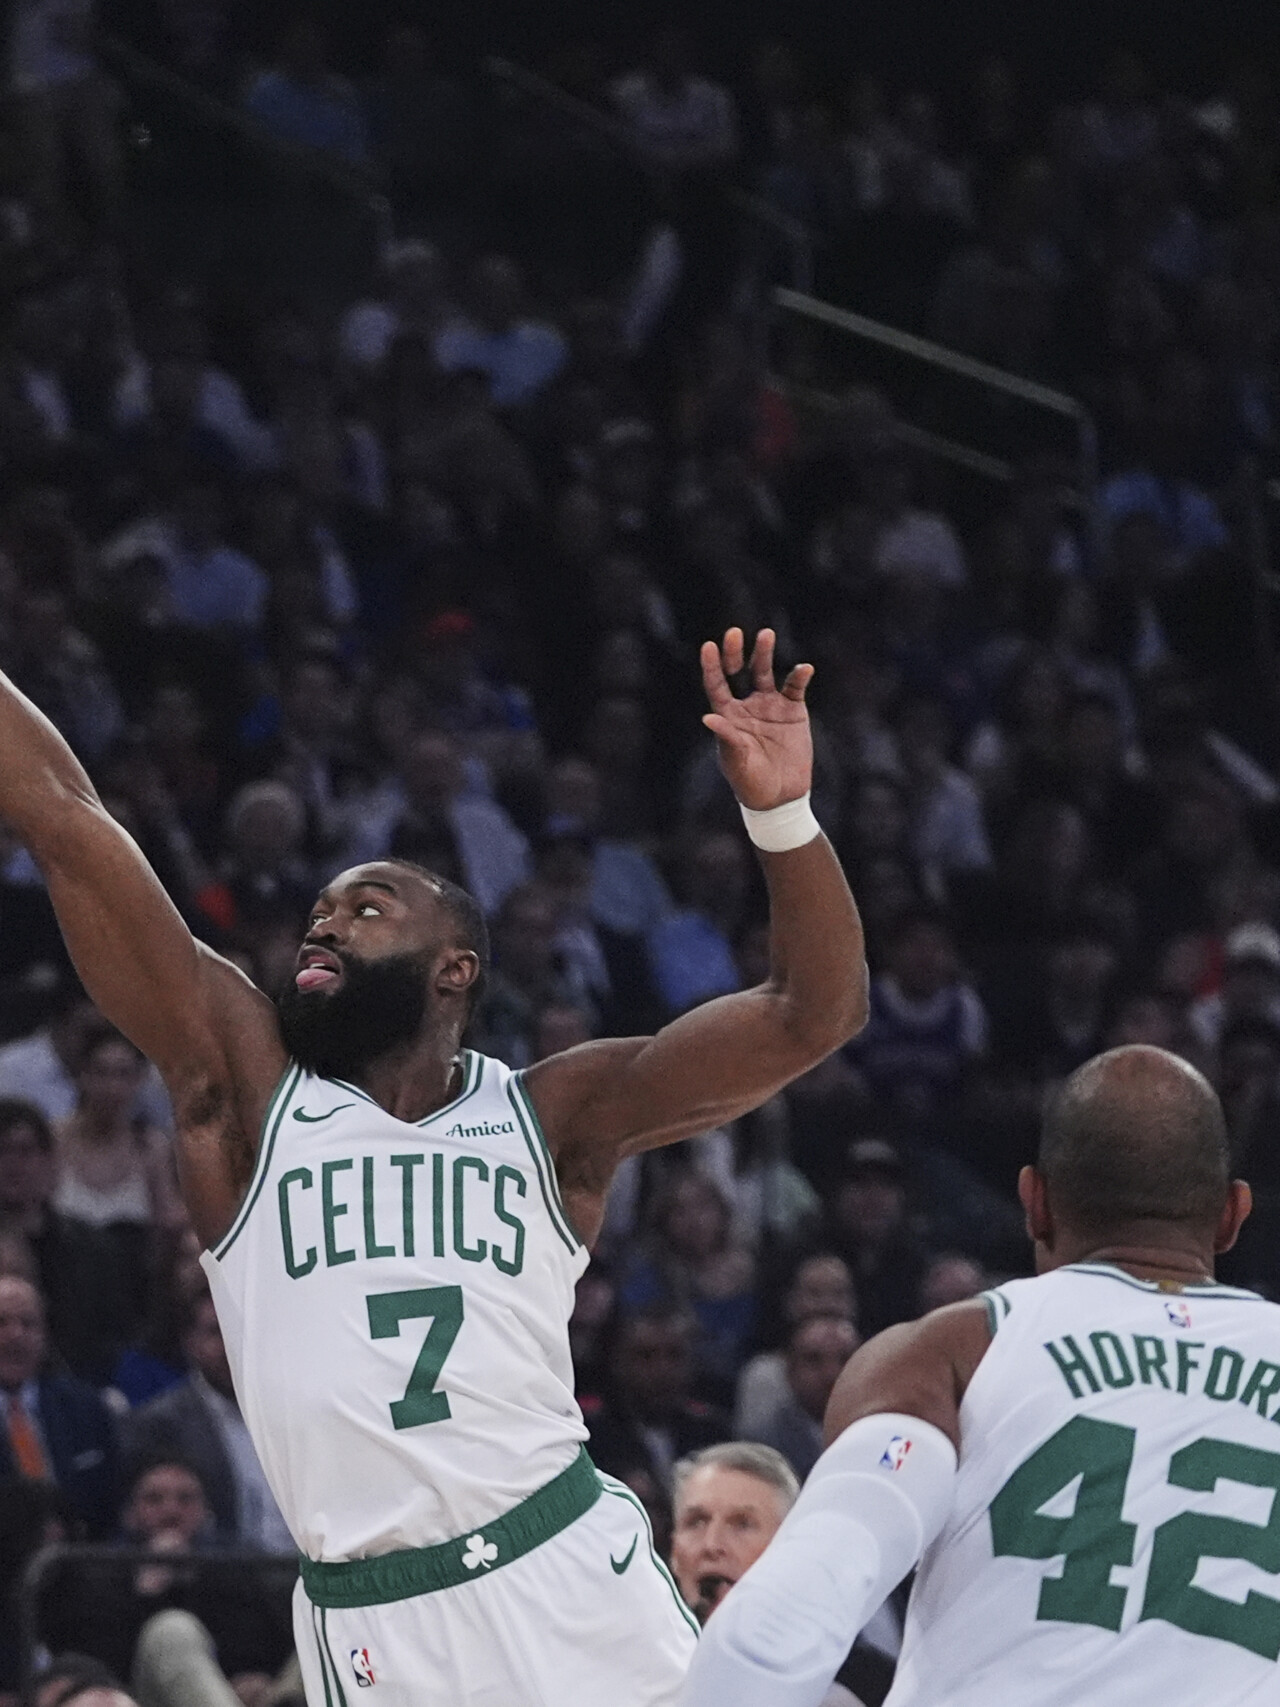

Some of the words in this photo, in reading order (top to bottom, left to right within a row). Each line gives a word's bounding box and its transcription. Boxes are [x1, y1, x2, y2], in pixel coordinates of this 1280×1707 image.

[445, 1121, 515, 1138] Amica
[278, 1153, 527, 1280] CELTICS
[366, 1285, 464, 1430] 7
[1043, 1330, 1280, 1426] HORFOR
[989, 1414, 1280, 1662] 42
